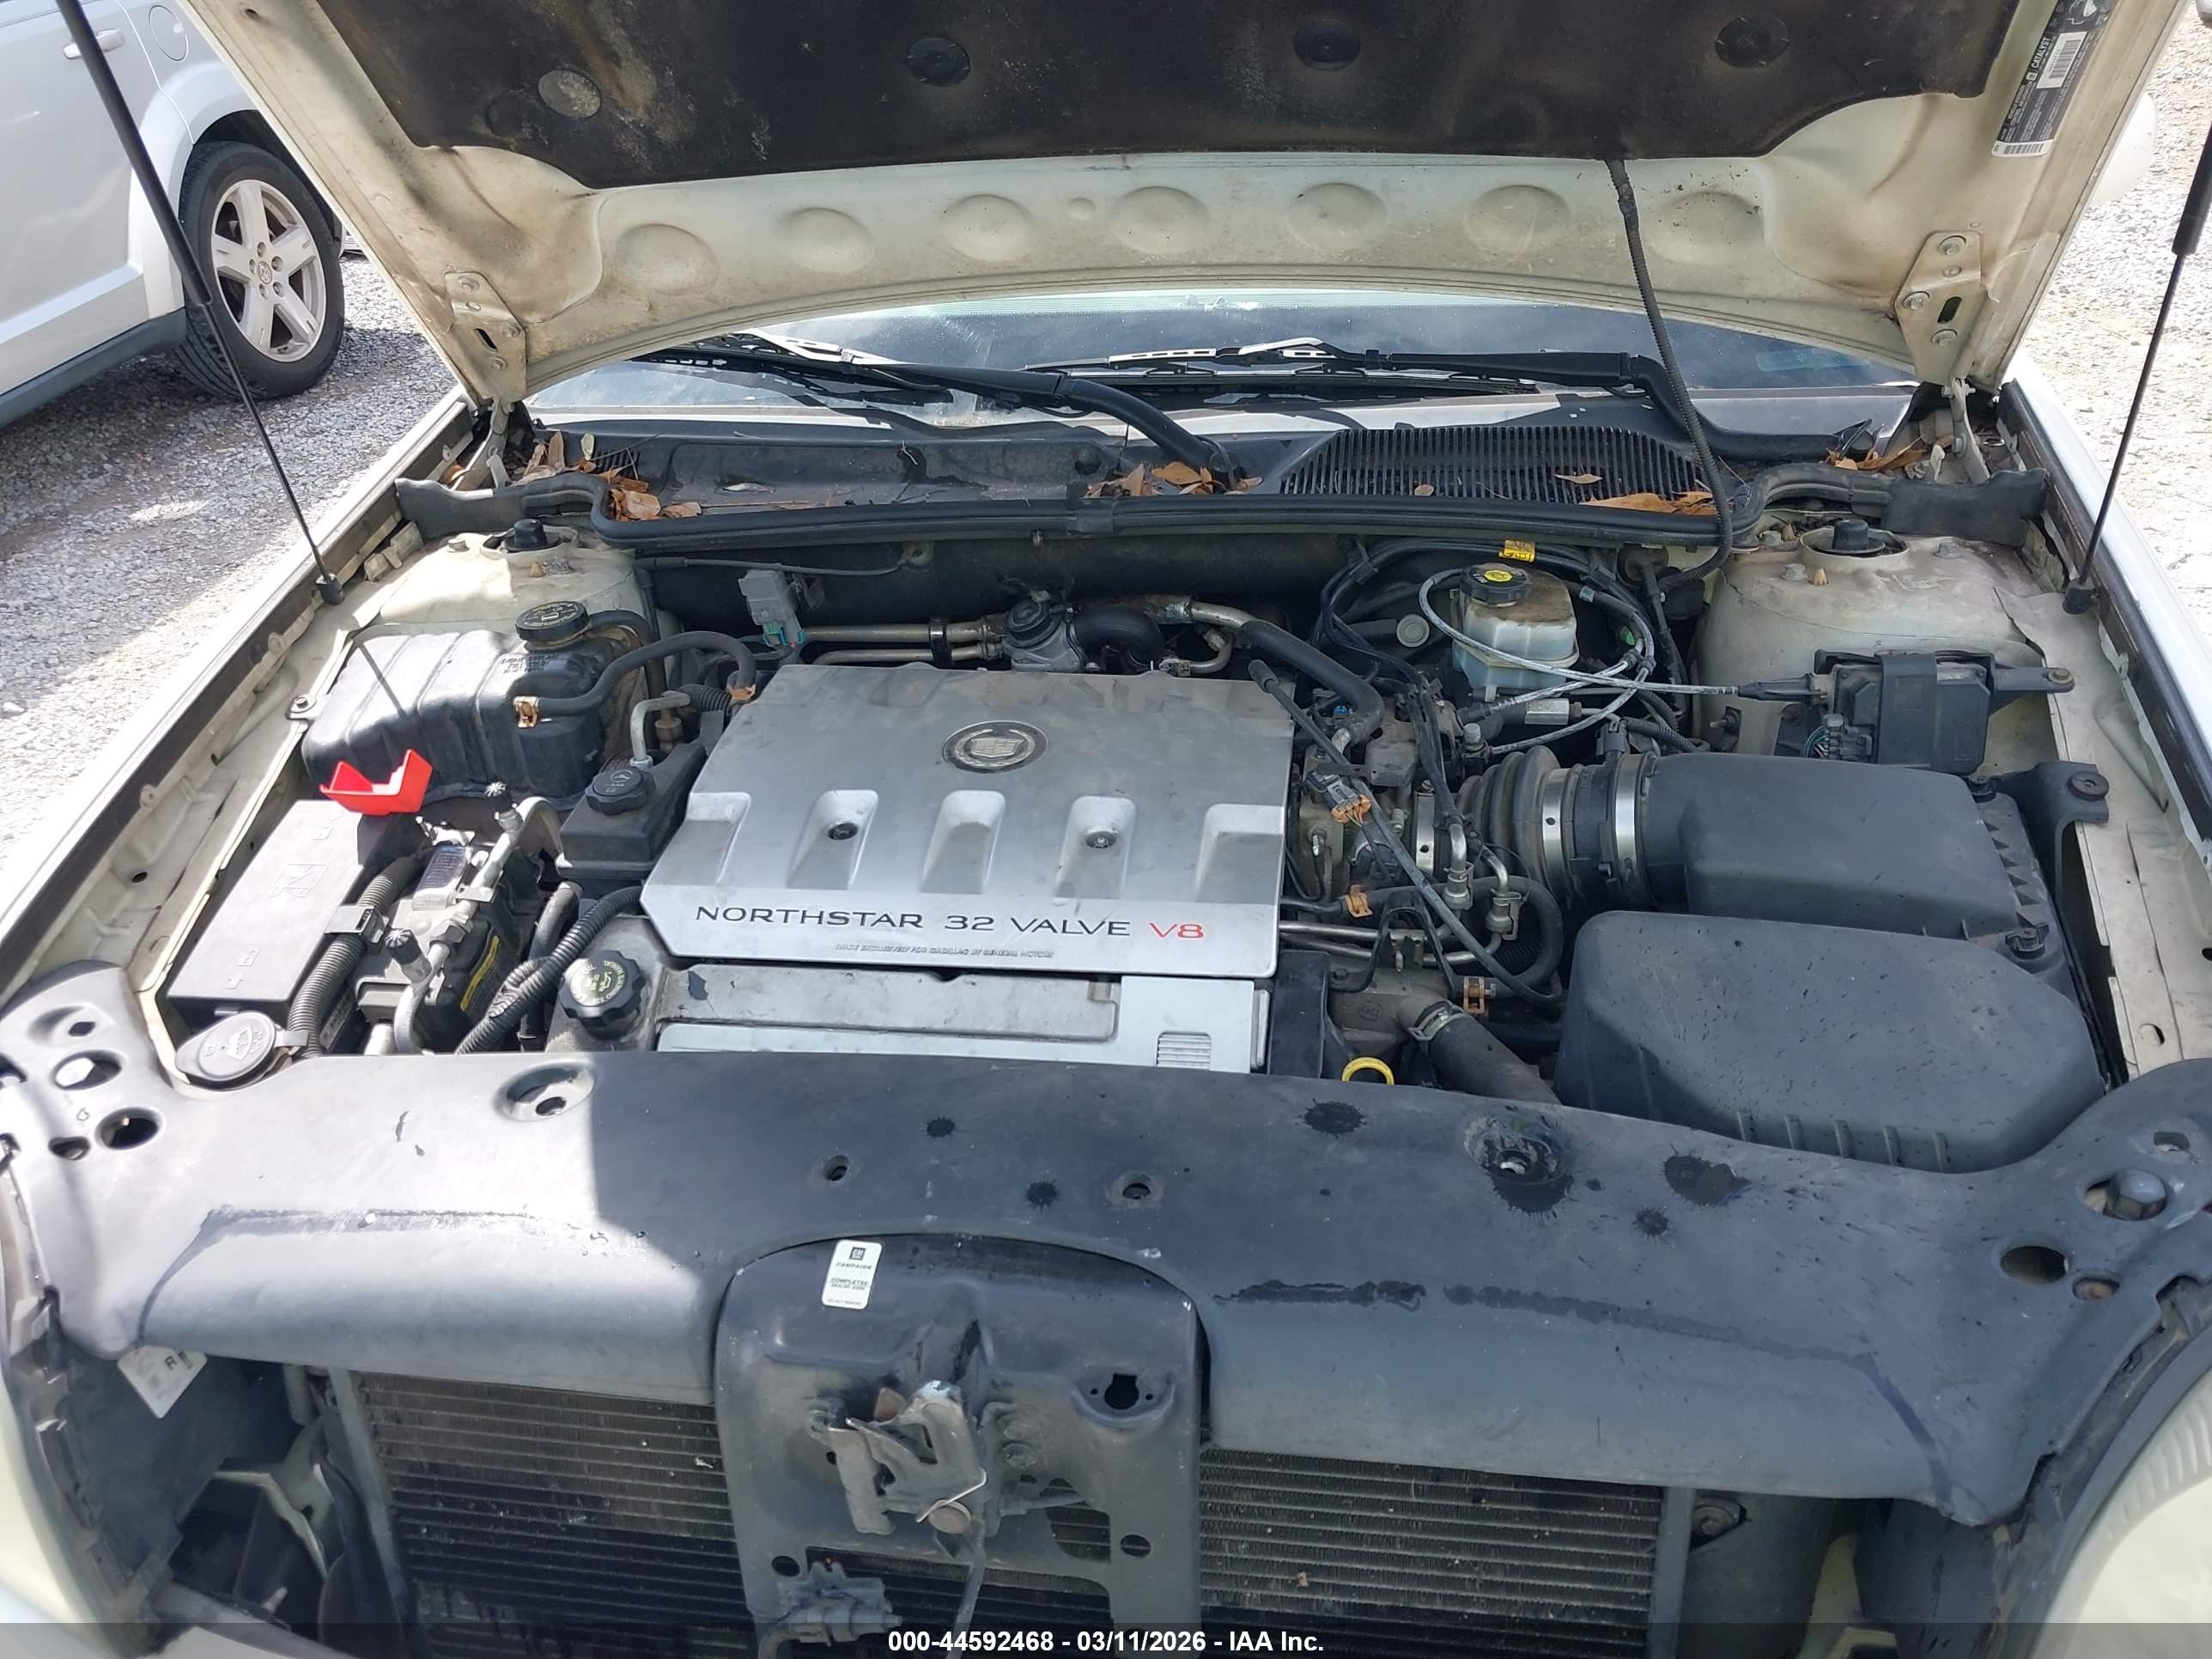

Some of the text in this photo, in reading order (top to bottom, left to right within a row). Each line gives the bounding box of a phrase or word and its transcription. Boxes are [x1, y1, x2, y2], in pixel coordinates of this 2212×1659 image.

[2031, 37, 2051, 69] CATALYST
[696, 906, 1205, 939] NORTHSTAR 32 VALVE V8
[836, 942, 860, 951] MADE
[929, 947, 969, 956] CADILLAC
